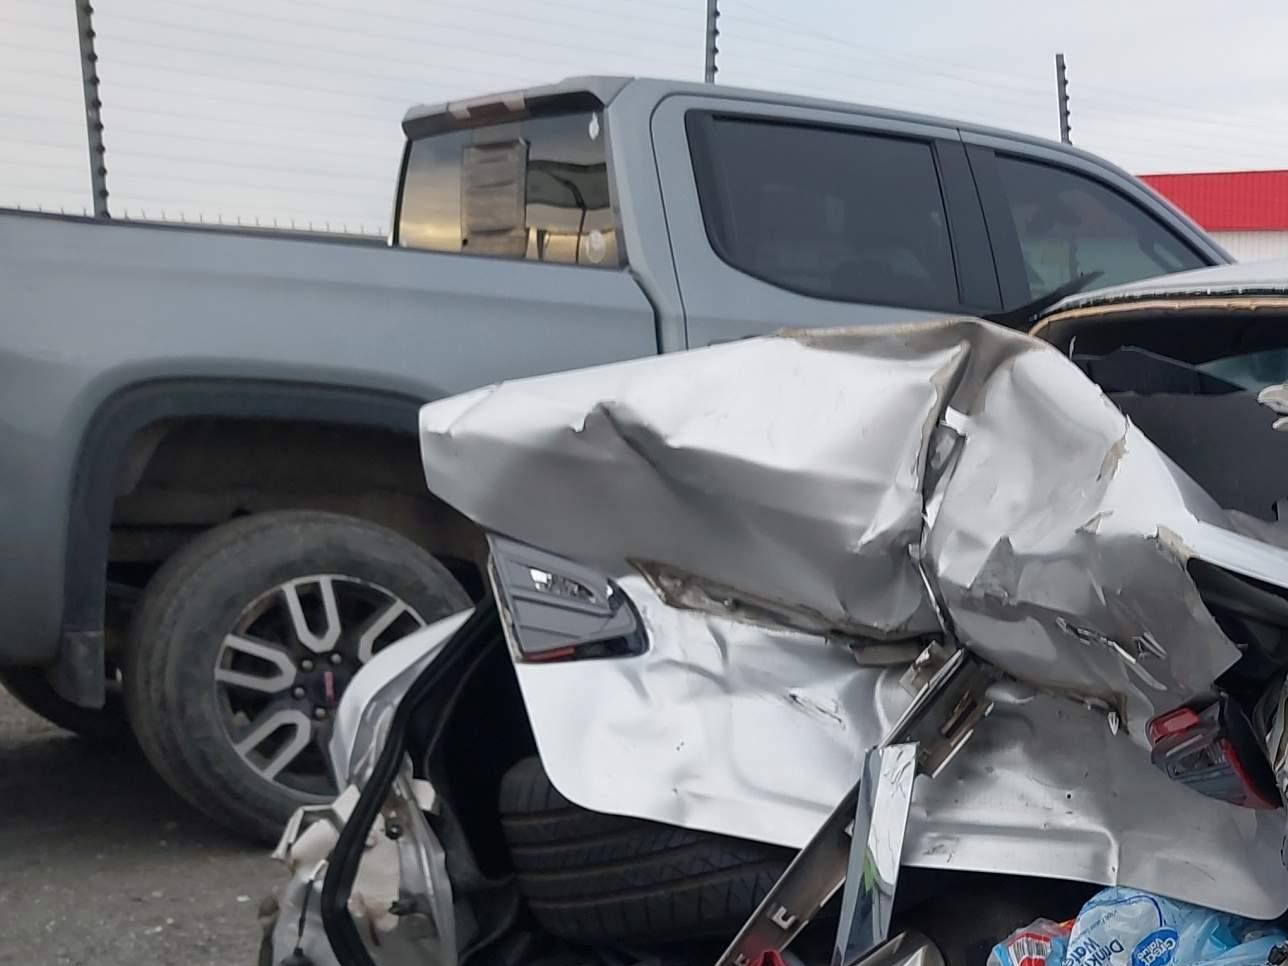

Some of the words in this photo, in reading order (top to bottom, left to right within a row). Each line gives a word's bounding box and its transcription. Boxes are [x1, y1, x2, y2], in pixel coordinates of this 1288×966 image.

[1062, 937, 1101, 966] Wate
[1136, 937, 1164, 960] Value
[1141, 937, 1176, 966] Great
